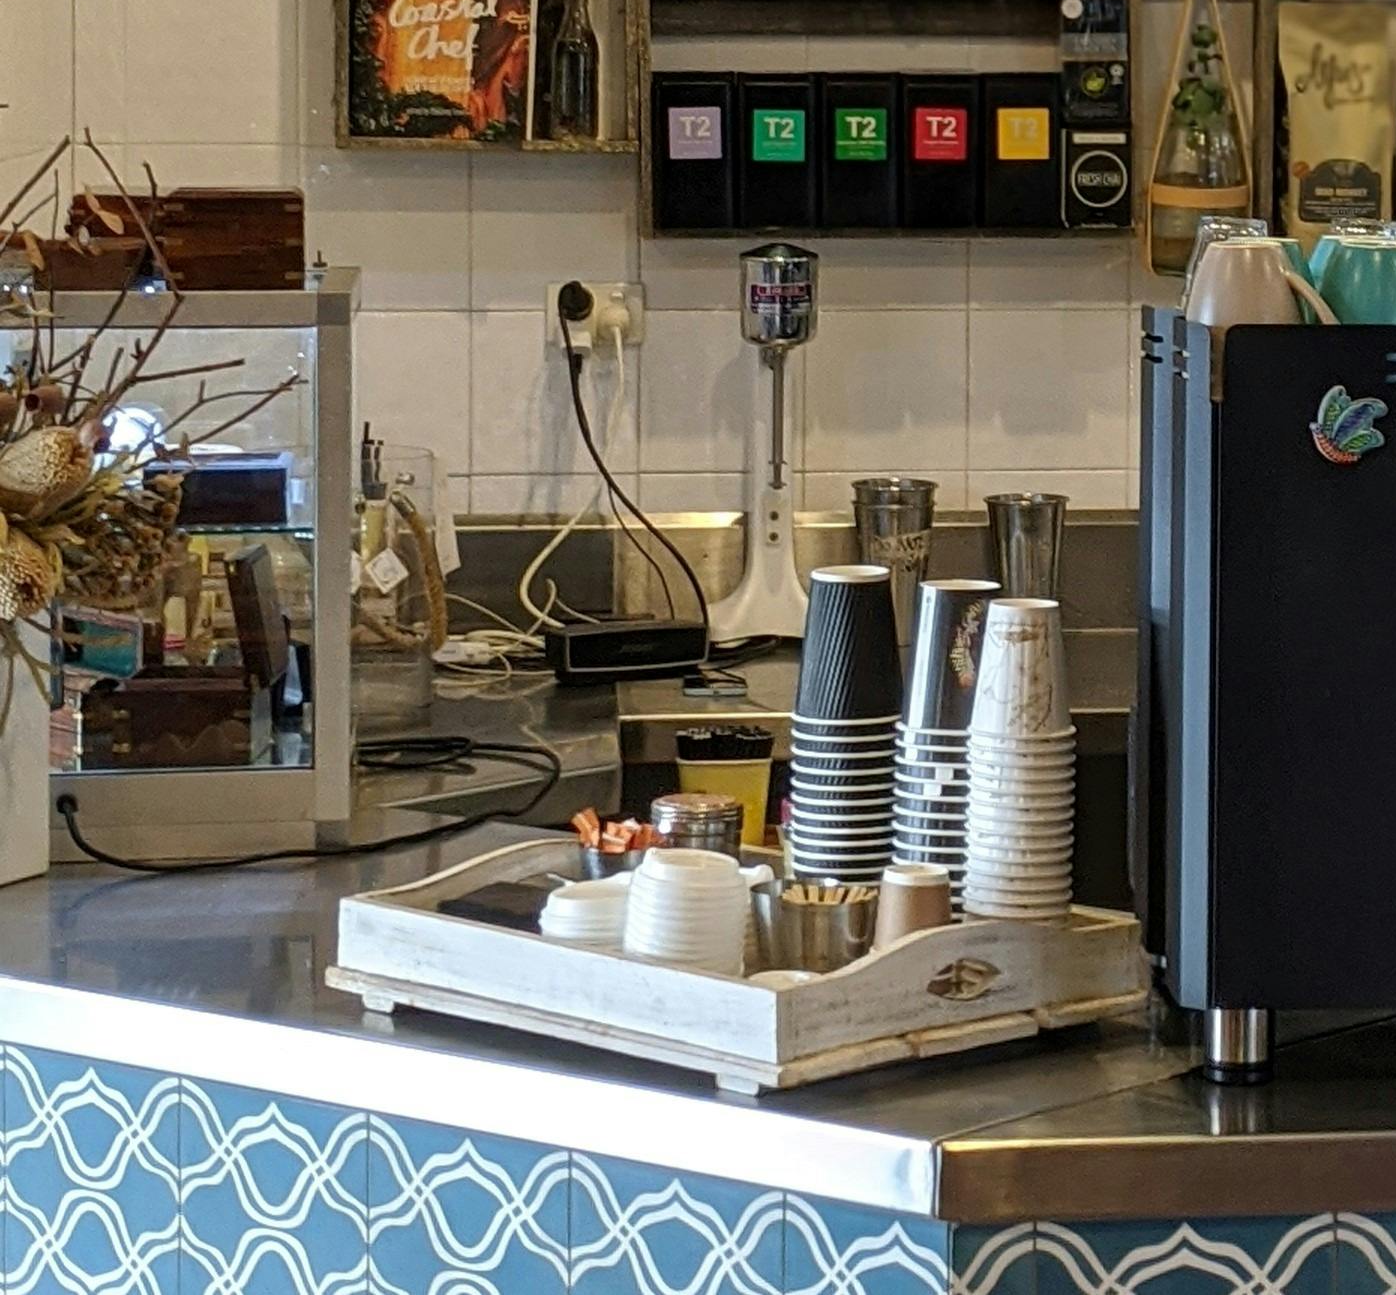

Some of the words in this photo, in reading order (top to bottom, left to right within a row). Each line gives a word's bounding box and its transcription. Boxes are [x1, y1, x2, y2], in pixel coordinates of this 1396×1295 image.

[679, 116, 711, 137] T2
[763, 117, 795, 139] T2
[845, 116, 877, 138] T2
[926, 116, 958, 138] T2
[1009, 118, 1039, 140] T2
